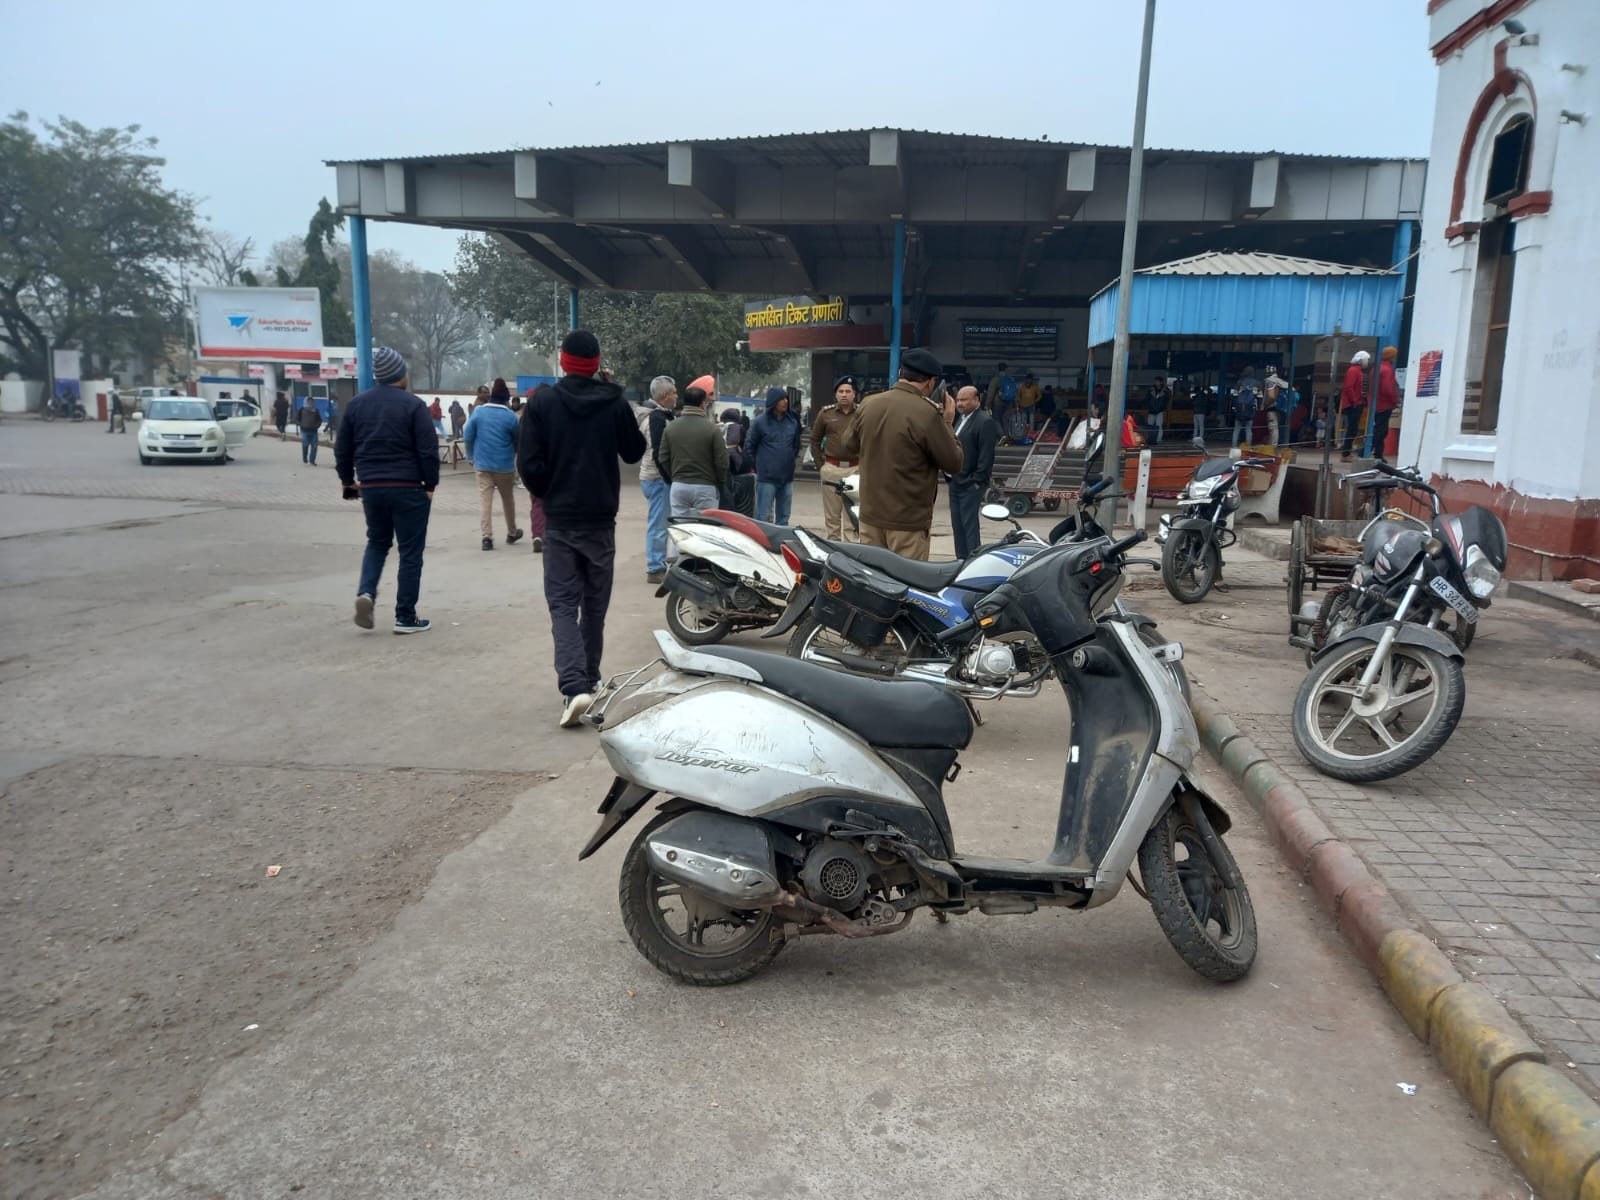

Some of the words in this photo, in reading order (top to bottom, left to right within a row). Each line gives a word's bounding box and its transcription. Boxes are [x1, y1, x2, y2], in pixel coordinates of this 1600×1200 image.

[745, 304, 784, 328] अनारक्षित
[786, 301, 810, 325] टिकट
[812, 296, 844, 323] प्रणाली
[1433, 579, 1448, 593] HR
[654, 751, 760, 774] Jupiter
